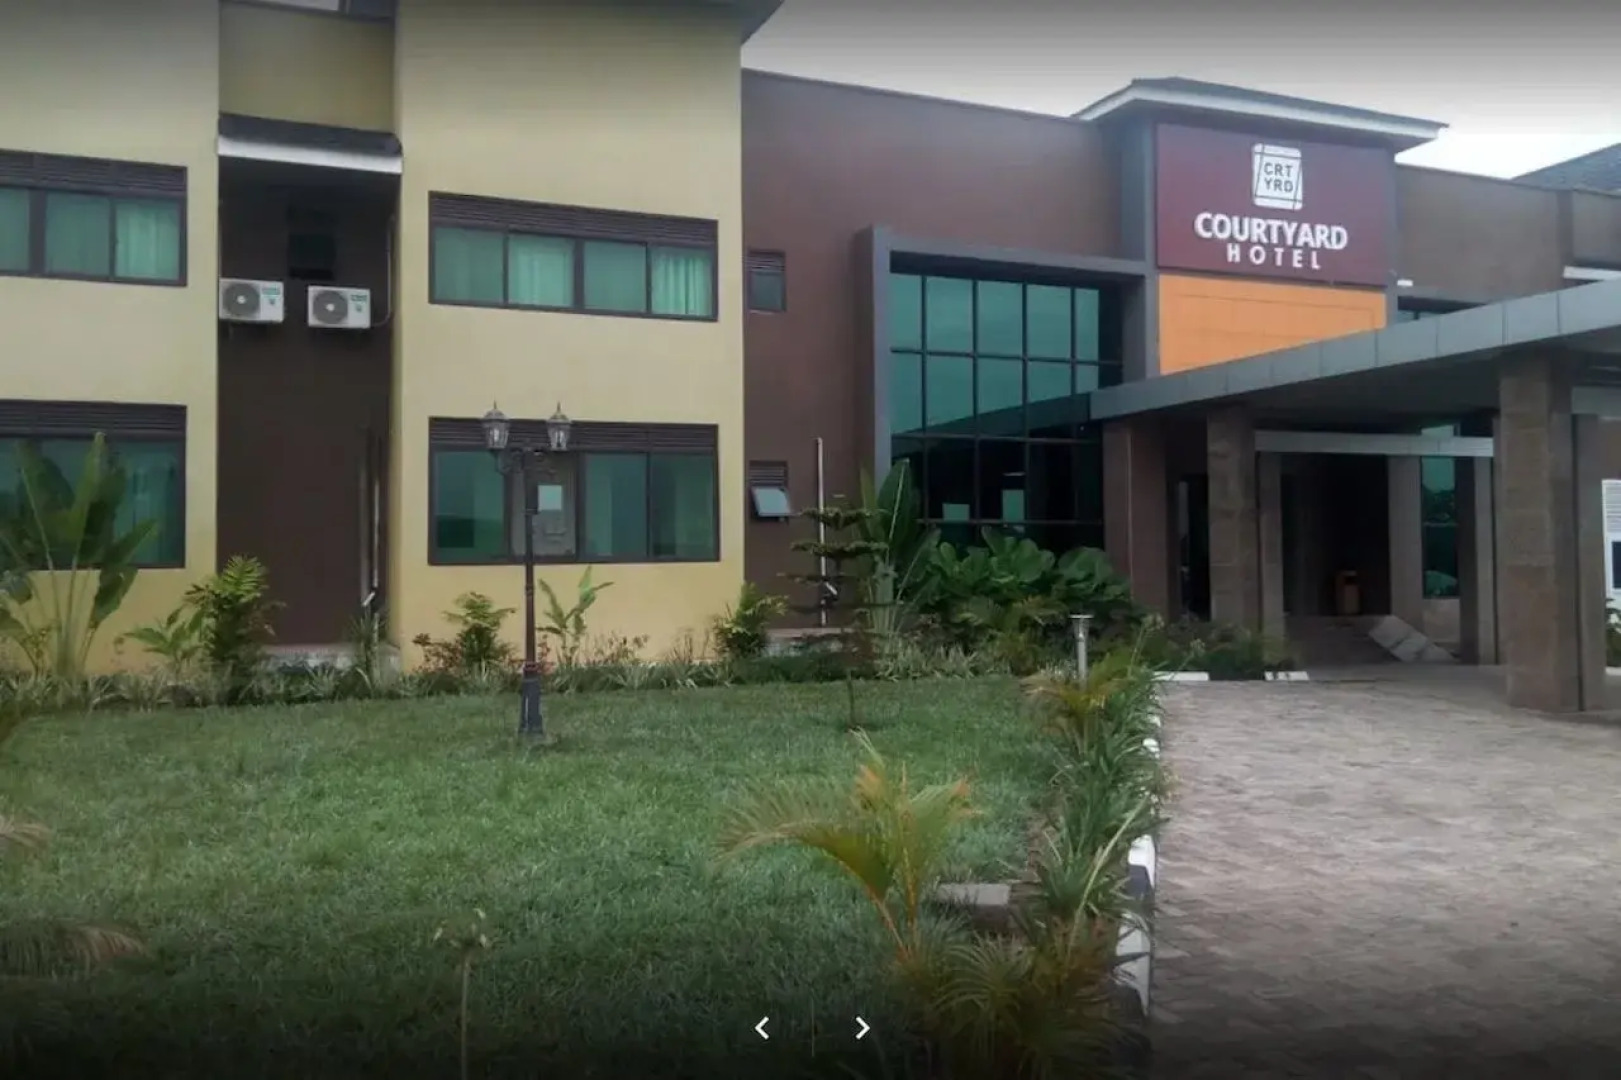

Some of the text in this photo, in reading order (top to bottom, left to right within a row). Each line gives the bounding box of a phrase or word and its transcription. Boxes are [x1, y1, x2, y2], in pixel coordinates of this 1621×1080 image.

[1264, 162, 1293, 178] CRT
[1264, 178, 1294, 192] YRD
[1194, 212, 1348, 250] COURTYARD
[1227, 243, 1321, 270] HOTEL
